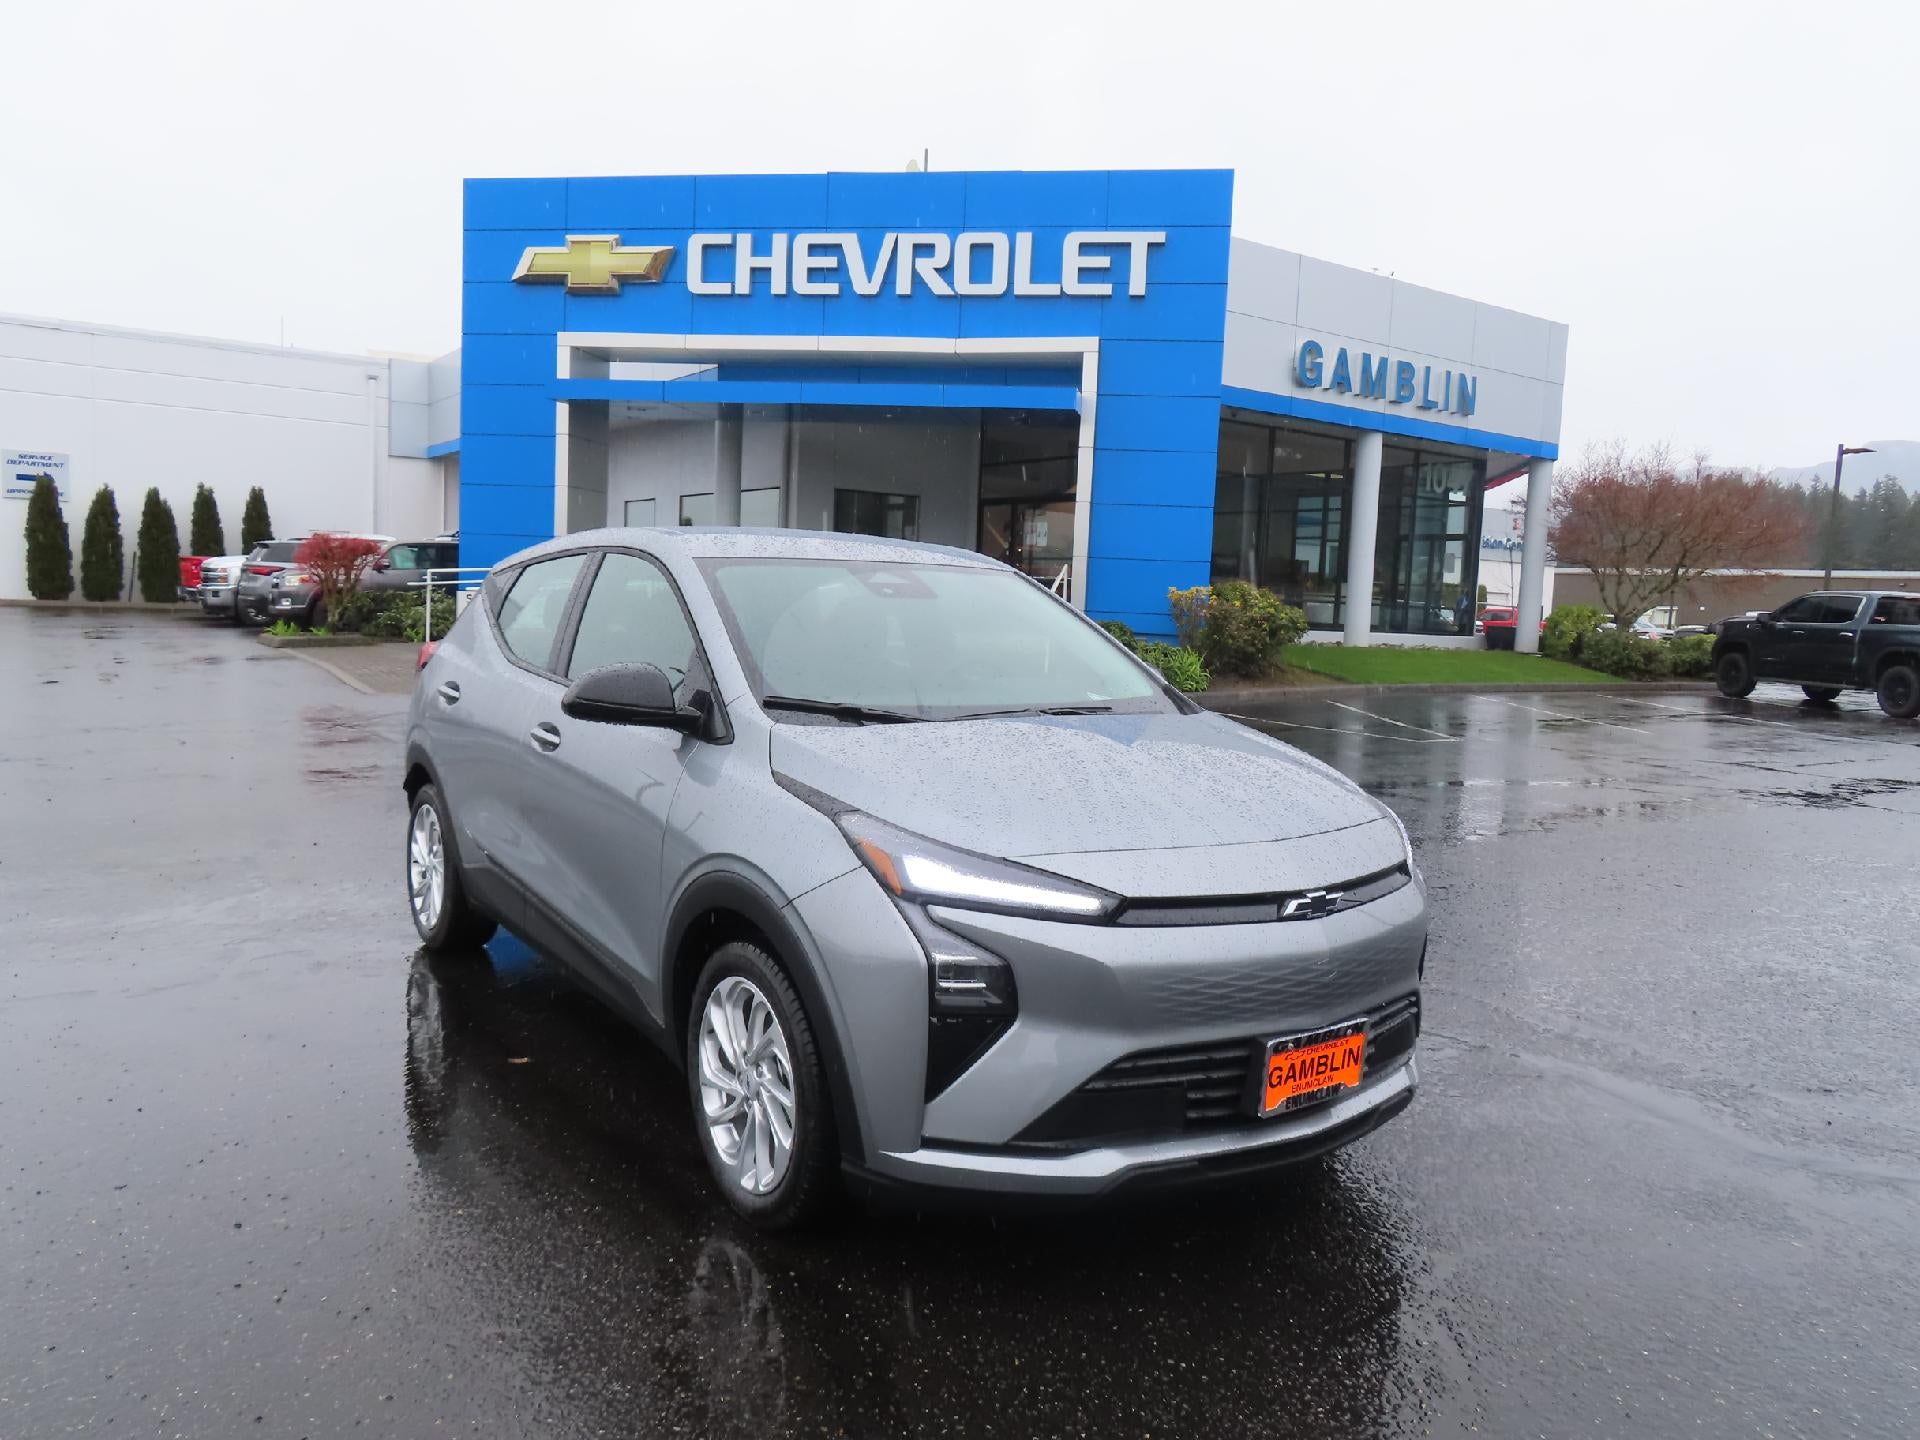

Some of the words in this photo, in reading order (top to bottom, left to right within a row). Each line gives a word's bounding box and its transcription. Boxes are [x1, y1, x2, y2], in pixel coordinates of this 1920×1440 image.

[686, 230, 1167, 298] CHEVROLET
[1297, 339, 1477, 416] GAMBLIN
[6, 459, 65, 468] DEPARTMENT
[1269, 1045, 1361, 1088] GAMBLIN
